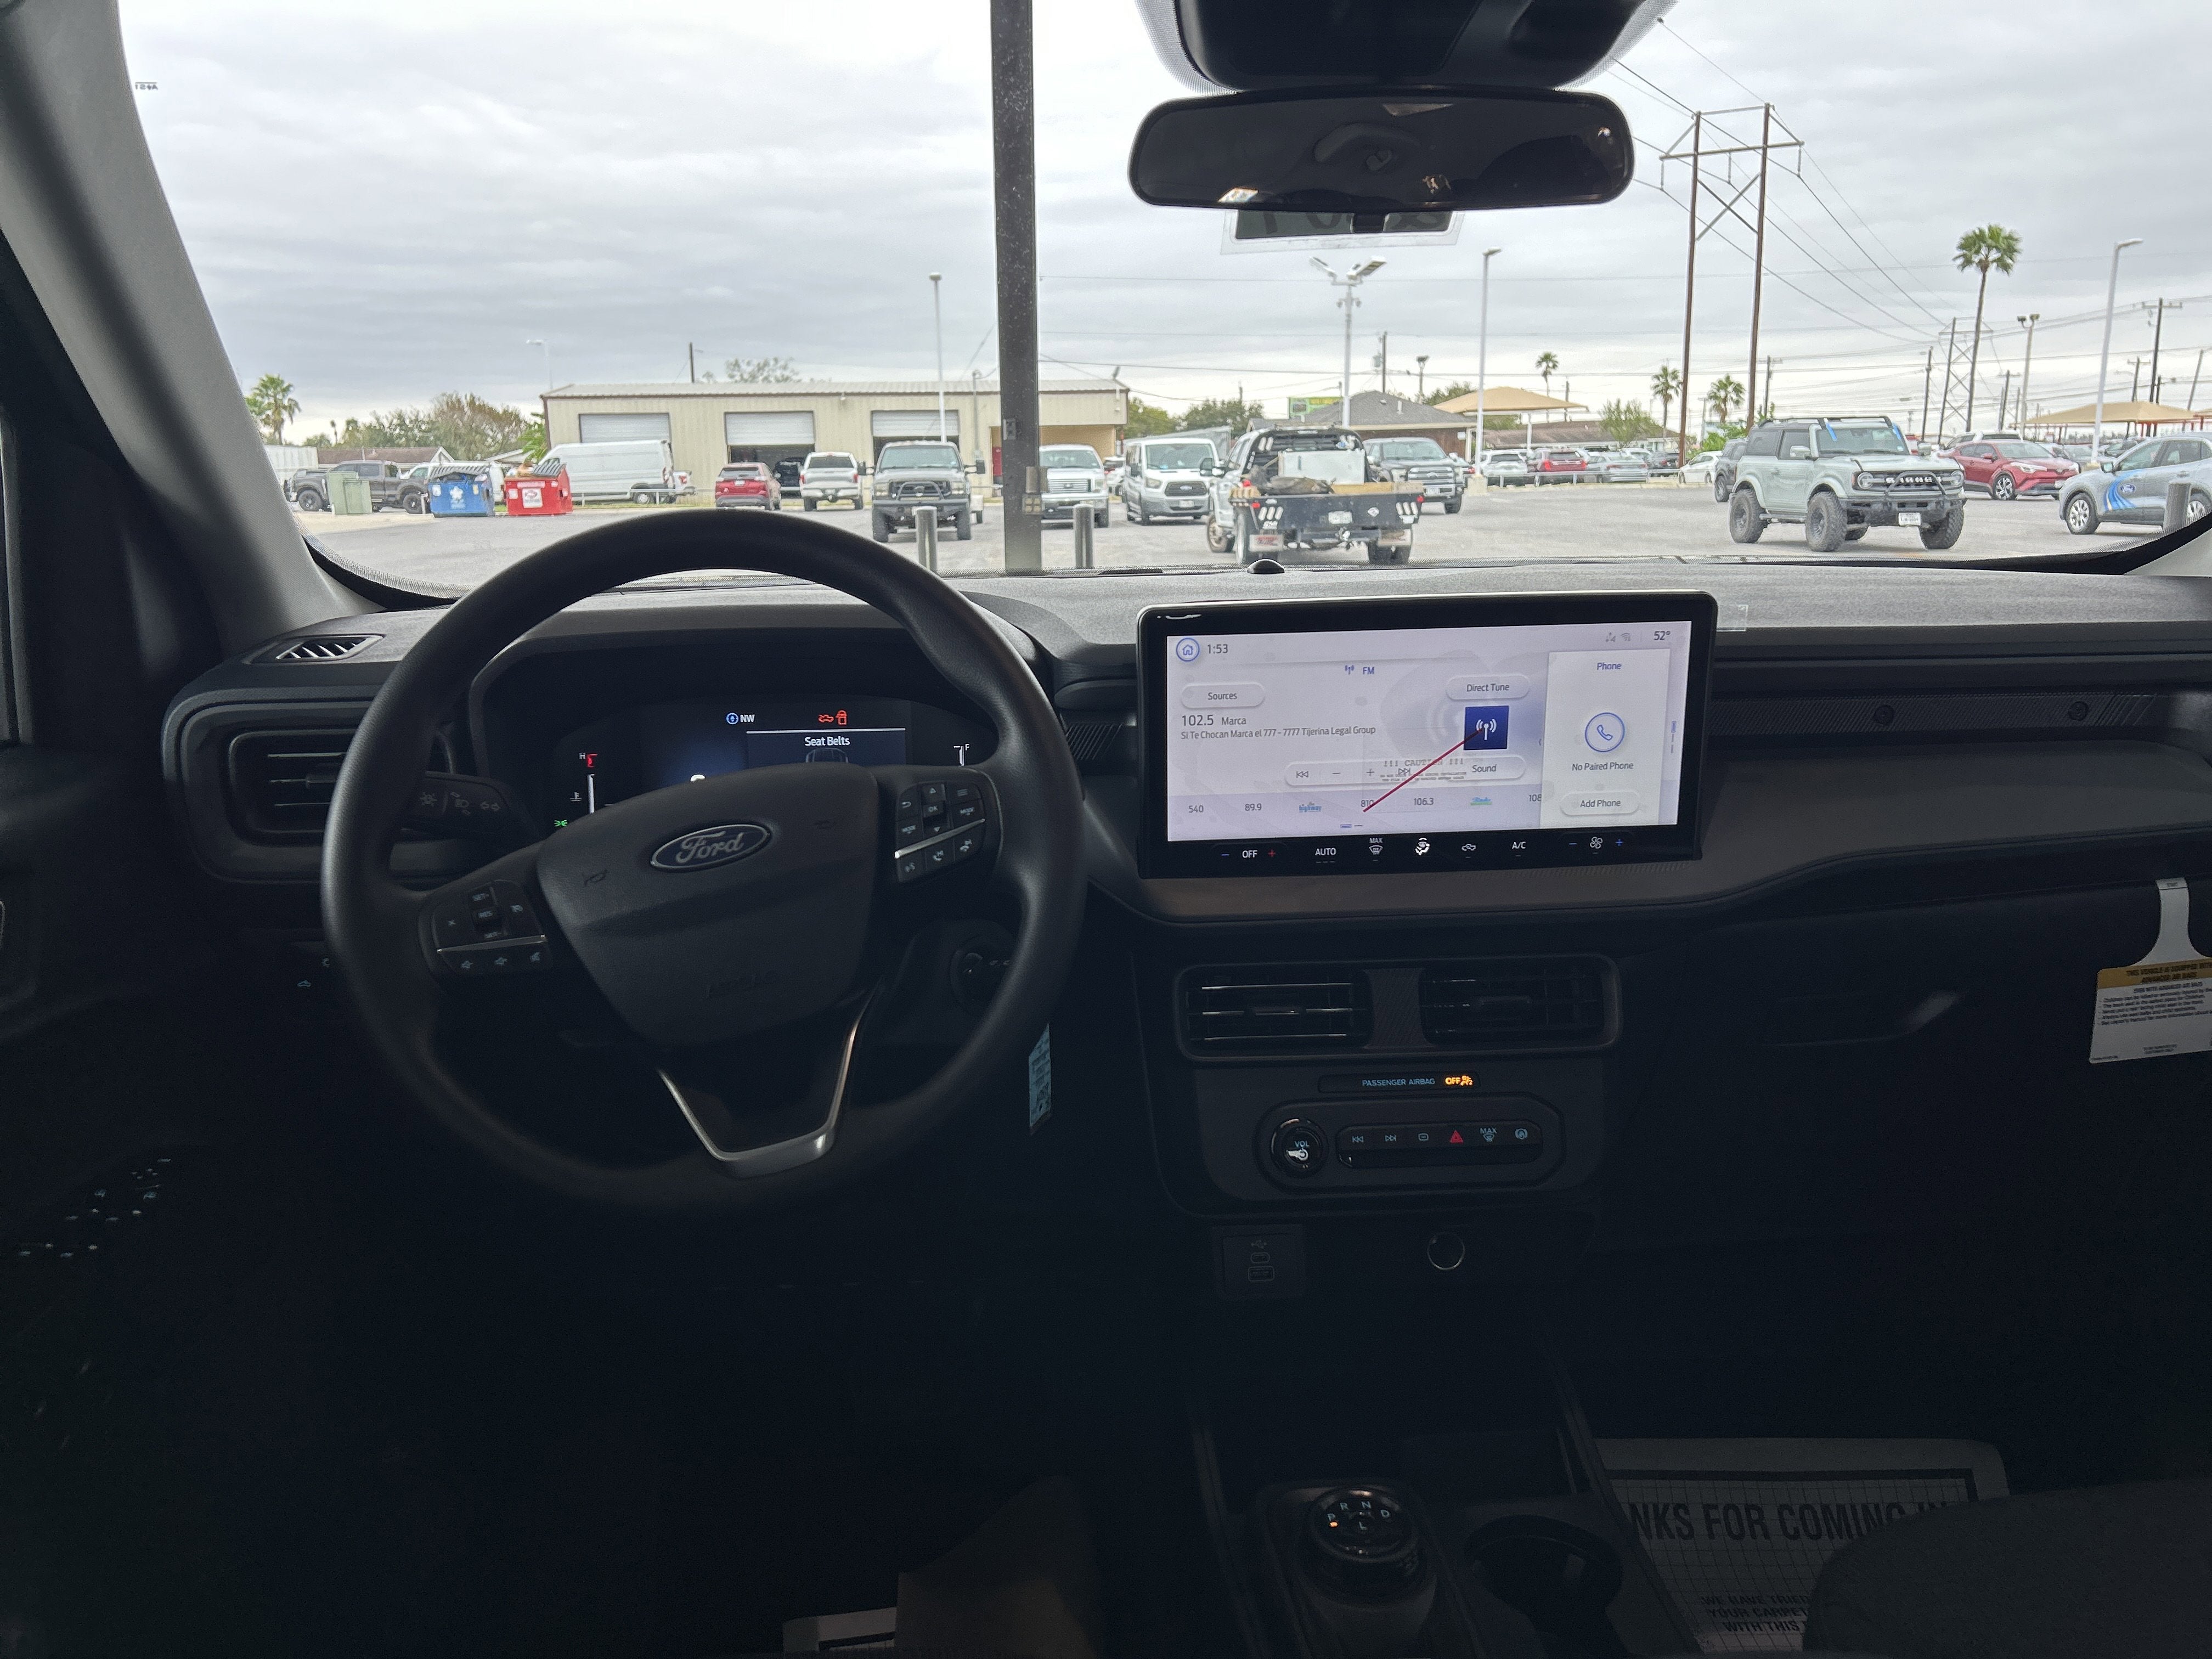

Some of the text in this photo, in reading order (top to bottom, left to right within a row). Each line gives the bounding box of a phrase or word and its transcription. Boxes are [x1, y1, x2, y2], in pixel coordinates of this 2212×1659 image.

[1653, 630, 1671, 641] 52°
[1207, 644, 1228, 654] 1:53
[1596, 662, 1622, 670] Phone
[1362, 667, 1375, 675] FM
[1466, 682, 1509, 692] Direct Tune
[1207, 692, 1238, 701] Sources
[740, 714, 755, 723] NW
[1182, 714, 1247, 726] 102.5 Marca
[1190, 731, 1199, 739] Te
[1200, 730, 1229, 739] Chocan
[1230, 730, 1254, 738] Marca
[1255, 729, 1262, 737] el
[1263, 729, 1277, 737] 777
[1282, 728, 1300, 736] 7777
[1301, 727, 1329, 737] Tijerina
[1330, 726, 1352, 736] Legal
[1352, 725, 1376, 735] Group
[804, 735, 850, 746] Seat Belts
[1472, 764, 1497, 772] Sound
[1584, 762, 1608, 771] Paired
[1414, 797, 1434, 806] 106.3
[1597, 799, 1621, 808] Phone
[1188, 805, 1204, 813] 540
[1245, 803, 1262, 811] 89.9
[675, 831, 744, 863] Ford
[1511, 841, 1526, 849] A/C
[1242, 848, 1337, 858] OFF AUTO
[1445, 1077, 1461, 1085] OFF
[1702, 1503, 1771, 1540] FOR
